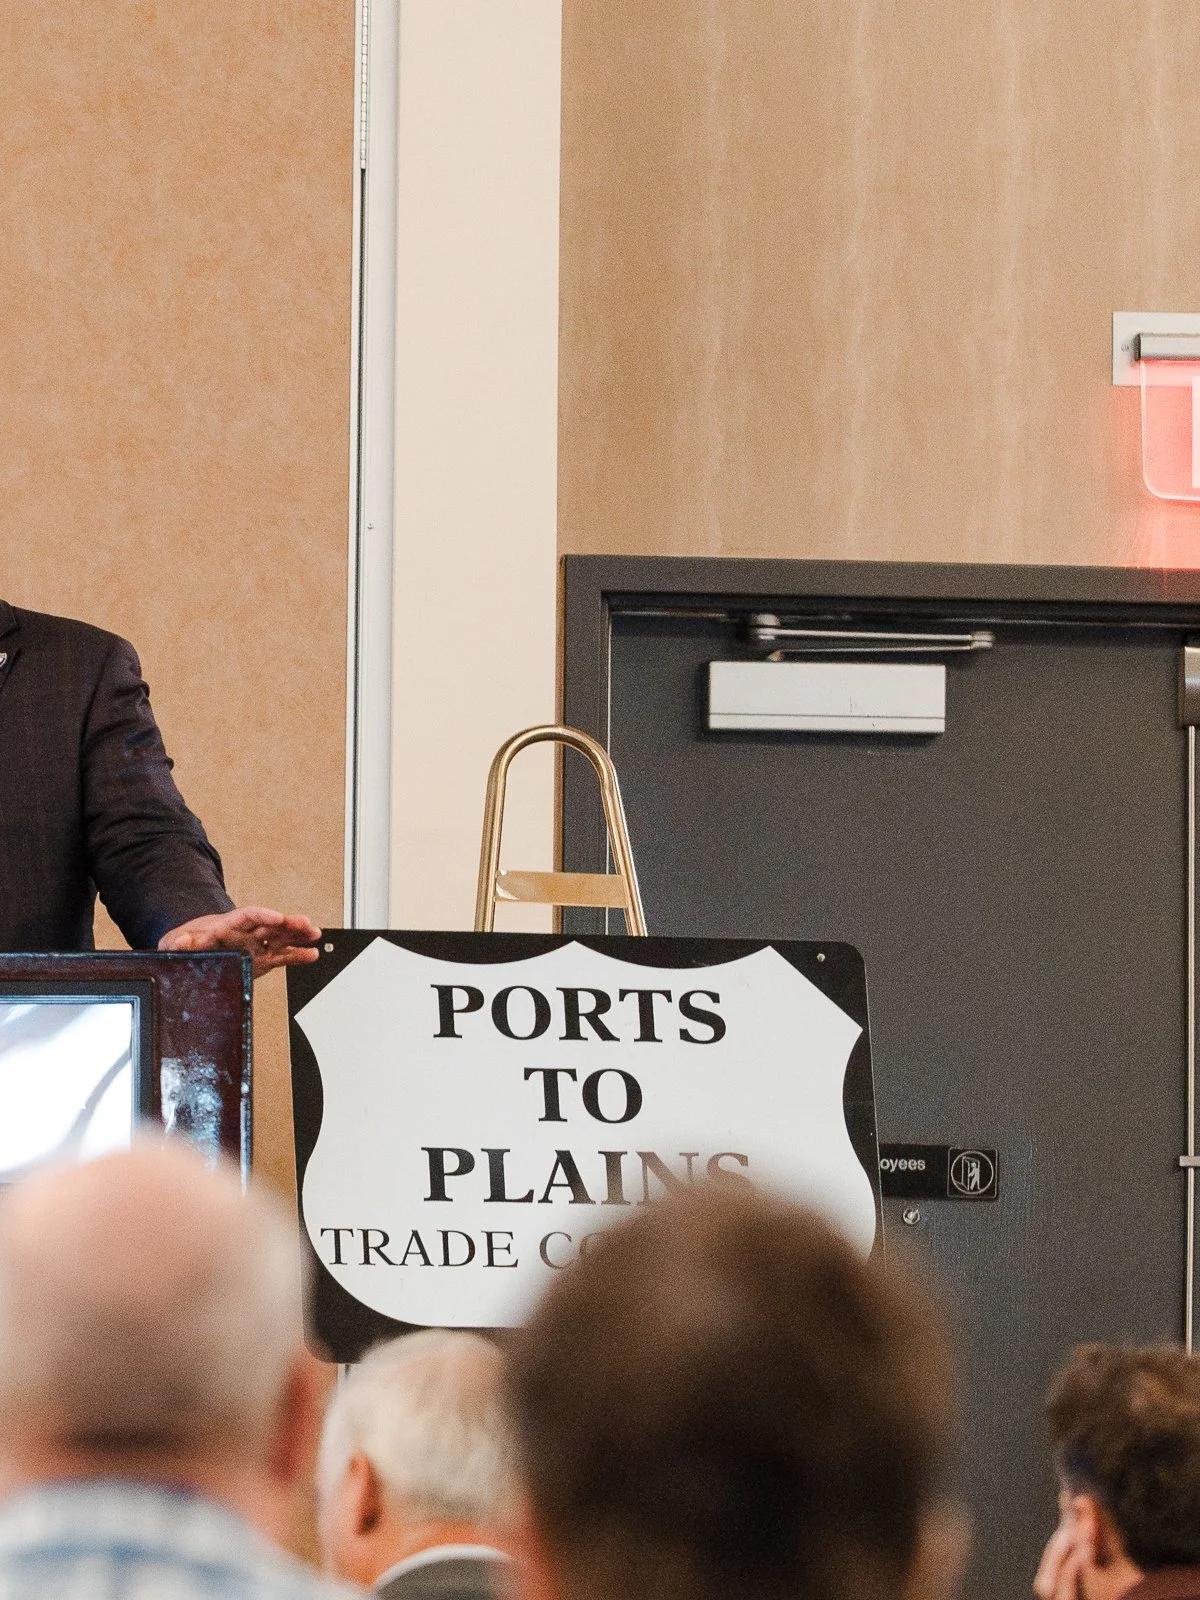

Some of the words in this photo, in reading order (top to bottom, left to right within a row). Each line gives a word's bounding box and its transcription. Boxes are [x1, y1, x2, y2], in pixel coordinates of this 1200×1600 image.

[430, 984, 727, 1045] PORTS
[523, 1066, 643, 1124] TO
[320, 1228, 519, 1269] TRADE
